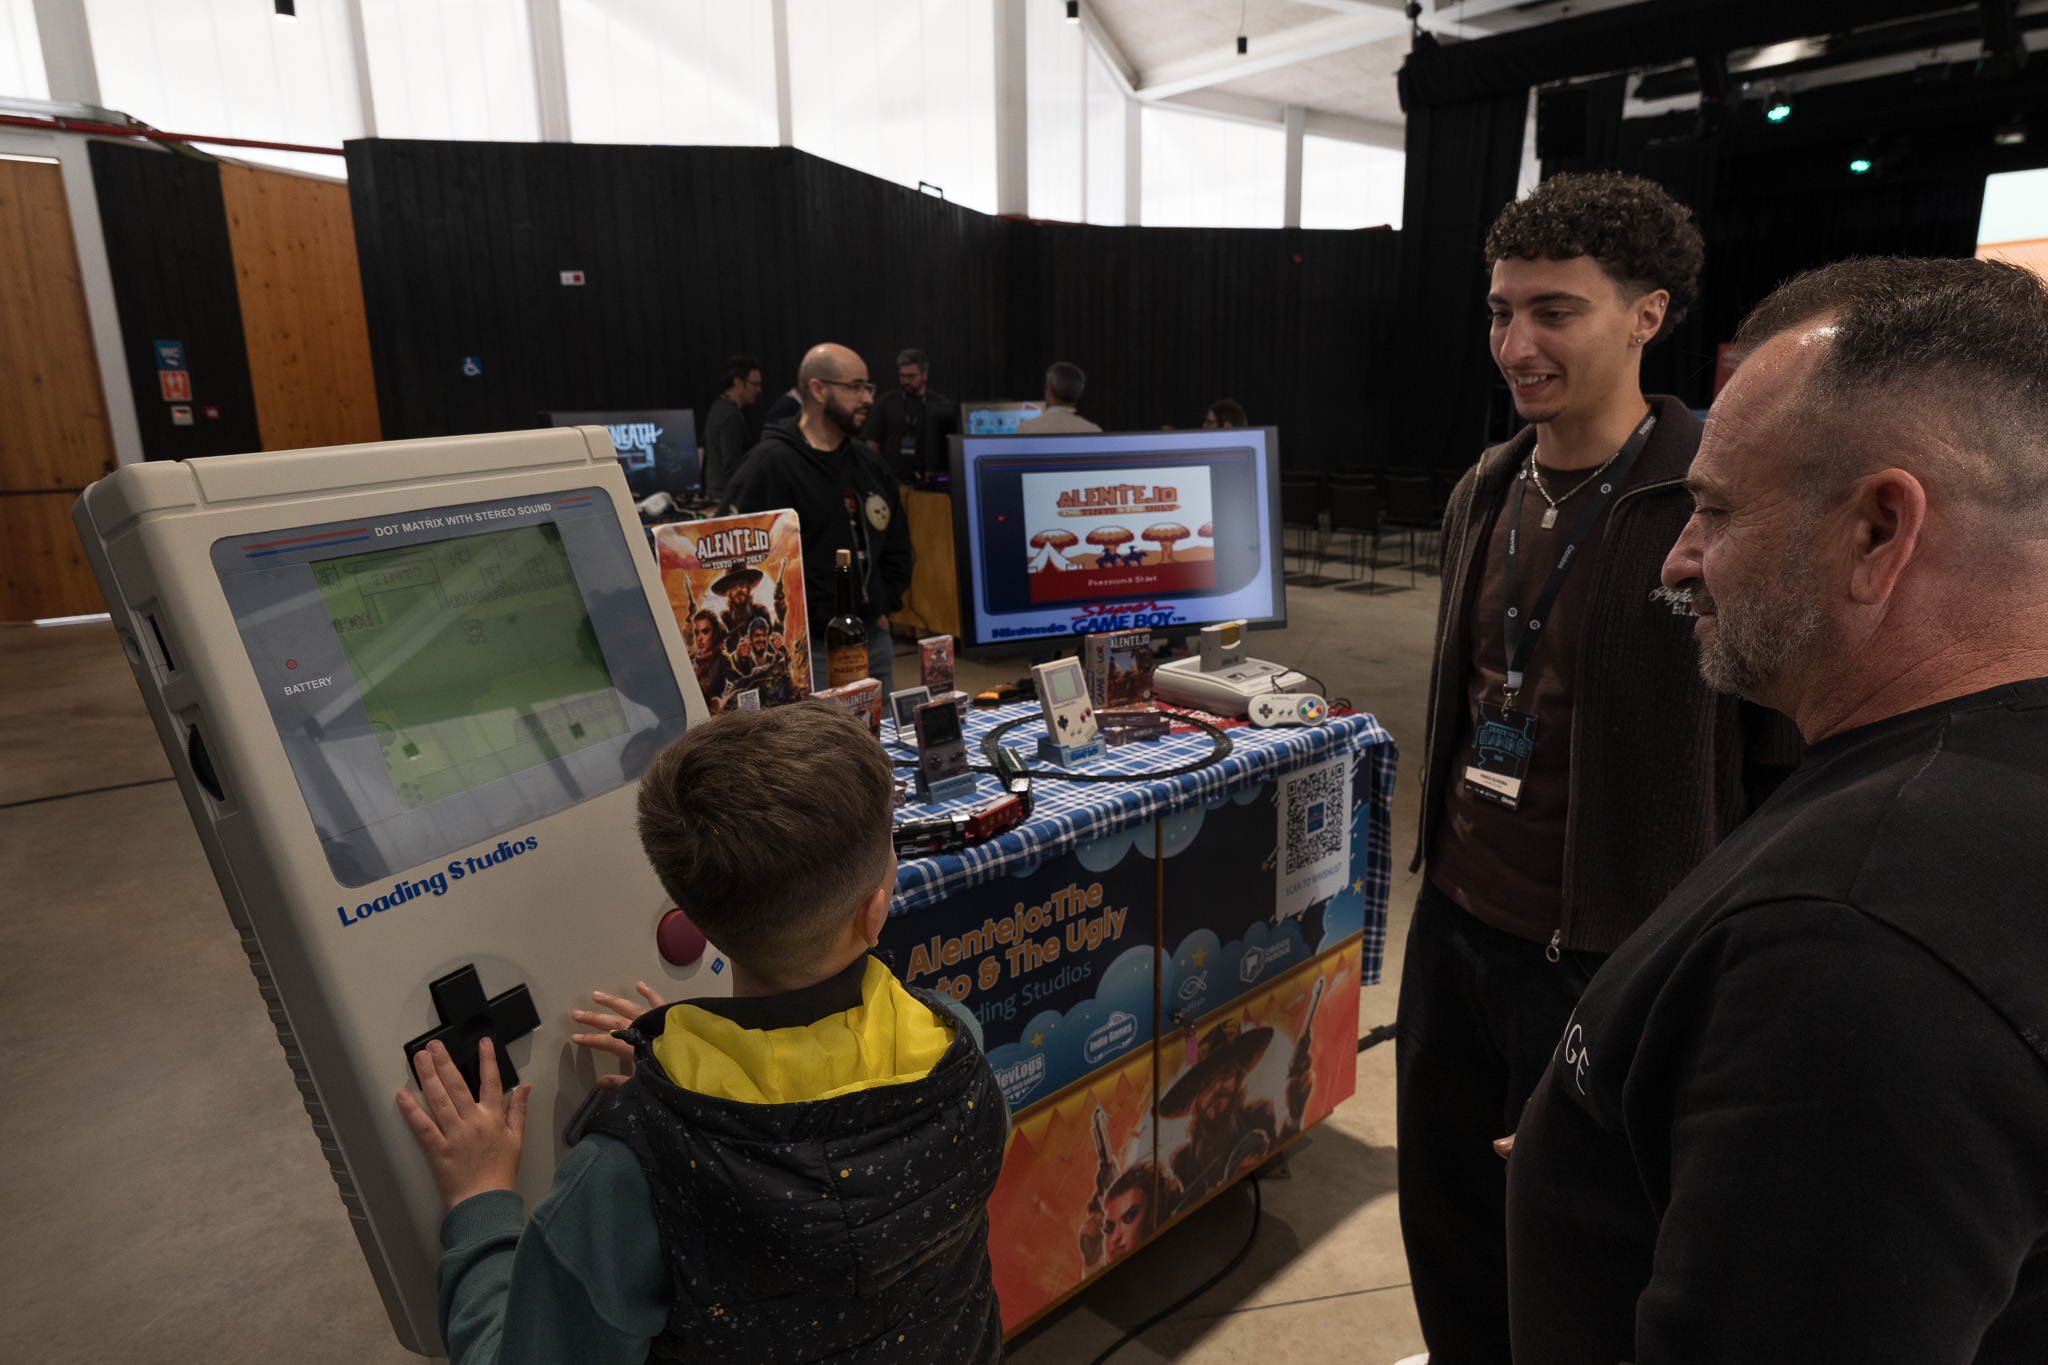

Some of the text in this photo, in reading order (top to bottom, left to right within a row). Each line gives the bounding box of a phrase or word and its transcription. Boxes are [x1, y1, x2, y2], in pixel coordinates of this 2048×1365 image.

[1057, 484, 1177, 508] ALENTEJO
[374, 502, 552, 537] DOT MATRIX WITH STEREO SOUND
[696, 527, 770, 561] ALENTEJO
[1135, 575, 1158, 583] Start
[1071, 600, 1175, 620] Super
[992, 623, 1067, 638] Nintendo
[1071, 615, 1129, 633] GAME
[1109, 633, 1151, 649] ALENTEJO
[283, 676, 332, 696] BATTERY
[337, 836, 538, 927] Loading Studios
[936, 906, 1128, 1001] to & The Ugly
[711, 957, 724, 975] B
[975, 961, 1092, 1025] ding Studios
[1109, 1023, 1132, 1044] Games
